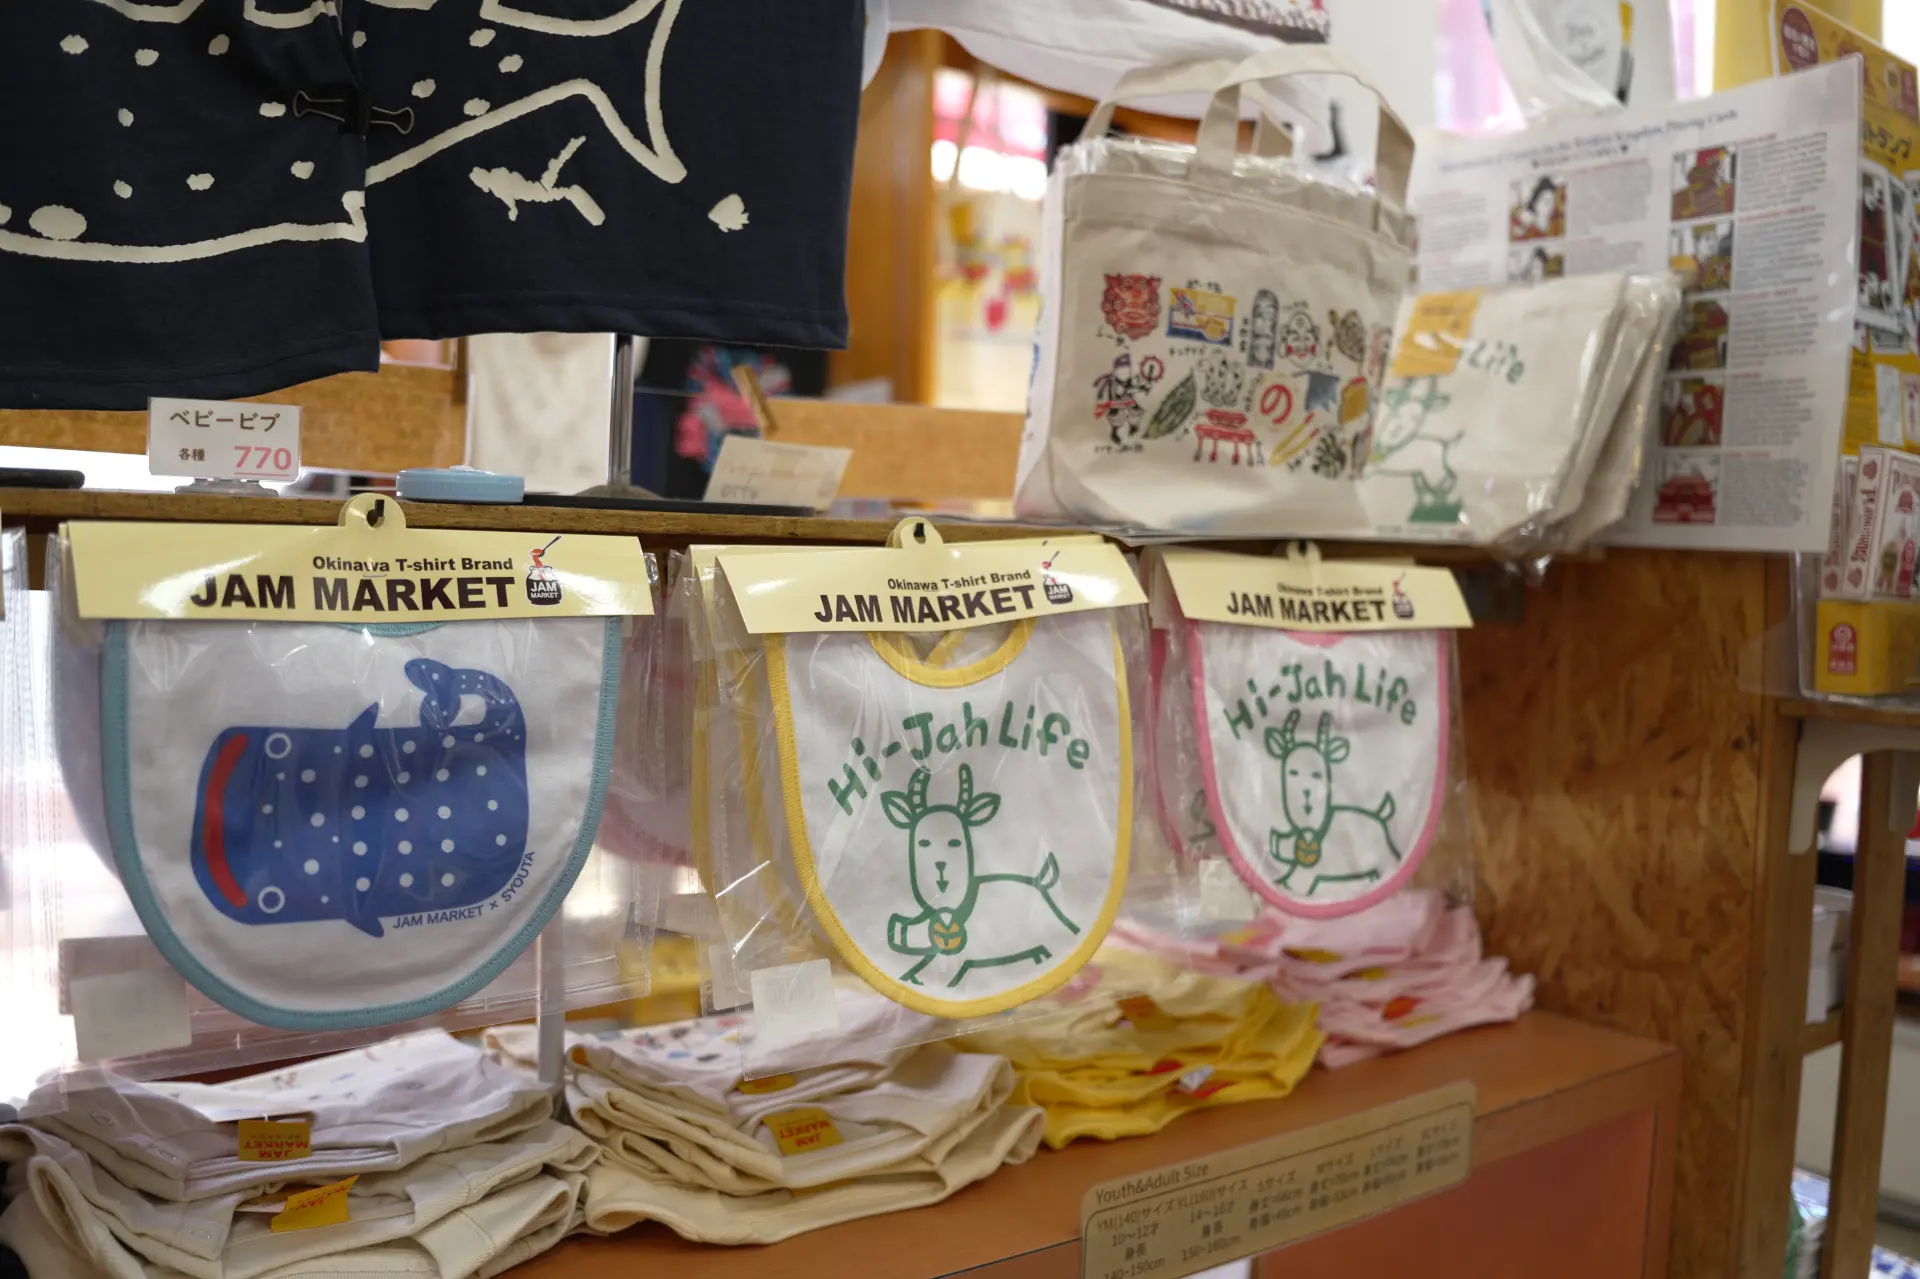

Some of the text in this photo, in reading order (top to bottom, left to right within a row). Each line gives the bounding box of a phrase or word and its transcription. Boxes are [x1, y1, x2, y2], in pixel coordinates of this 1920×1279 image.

[170, 409, 281, 432] ベビービブ
[178, 446, 292, 471] 各種 770
[313, 556, 514, 572] Okinawa T-shirt Brand
[190, 573, 516, 612] JAM MARKET
[530, 581, 558, 593] JAM
[887, 569, 1032, 593] Okinawa T-shirt Brand
[1048, 585, 1070, 595] JAM
[814, 584, 1036, 624] JAM MARKET
[1227, 592, 1274, 619] JAM
[1279, 597, 1386, 623] MARKET
[1354, 662, 1417, 726] Life
[998, 700, 1090, 770] Life
[393, 913, 423, 929] JAM
[426, 904, 485, 925] MARKET
[500, 850, 535, 902] SYOUTA
[779, 1120, 831, 1140] MARKET
[795, 1133, 821, 1147] JAM
[243, 1140, 309, 1149] MARKET
[259, 1149, 293, 1158] JAM
[1095, 1164, 1210, 1204] Youth&Adult Size
